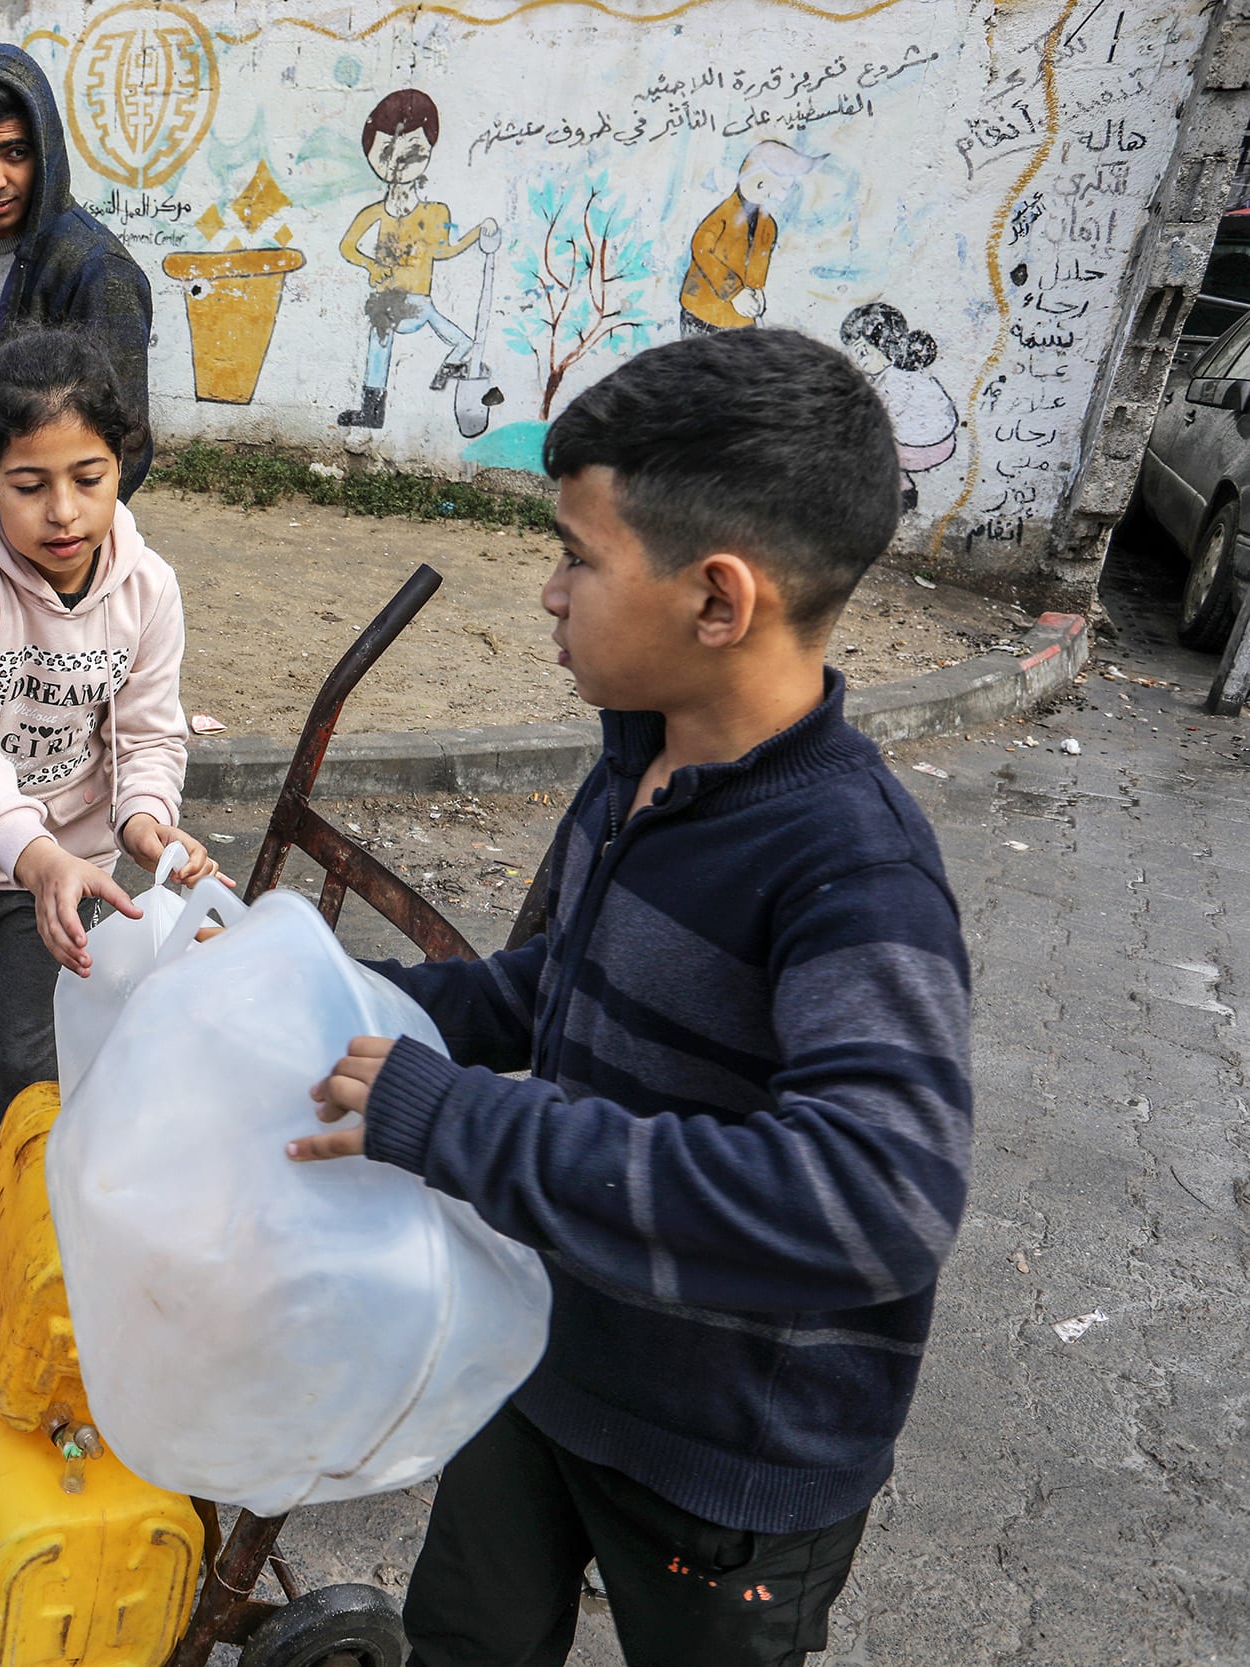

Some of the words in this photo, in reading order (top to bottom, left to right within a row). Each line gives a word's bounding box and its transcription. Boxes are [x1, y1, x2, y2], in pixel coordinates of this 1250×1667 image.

[857, 44, 940, 88] مشروع
[613, 109, 647, 146] في
[150, 194, 192, 223] مركز
